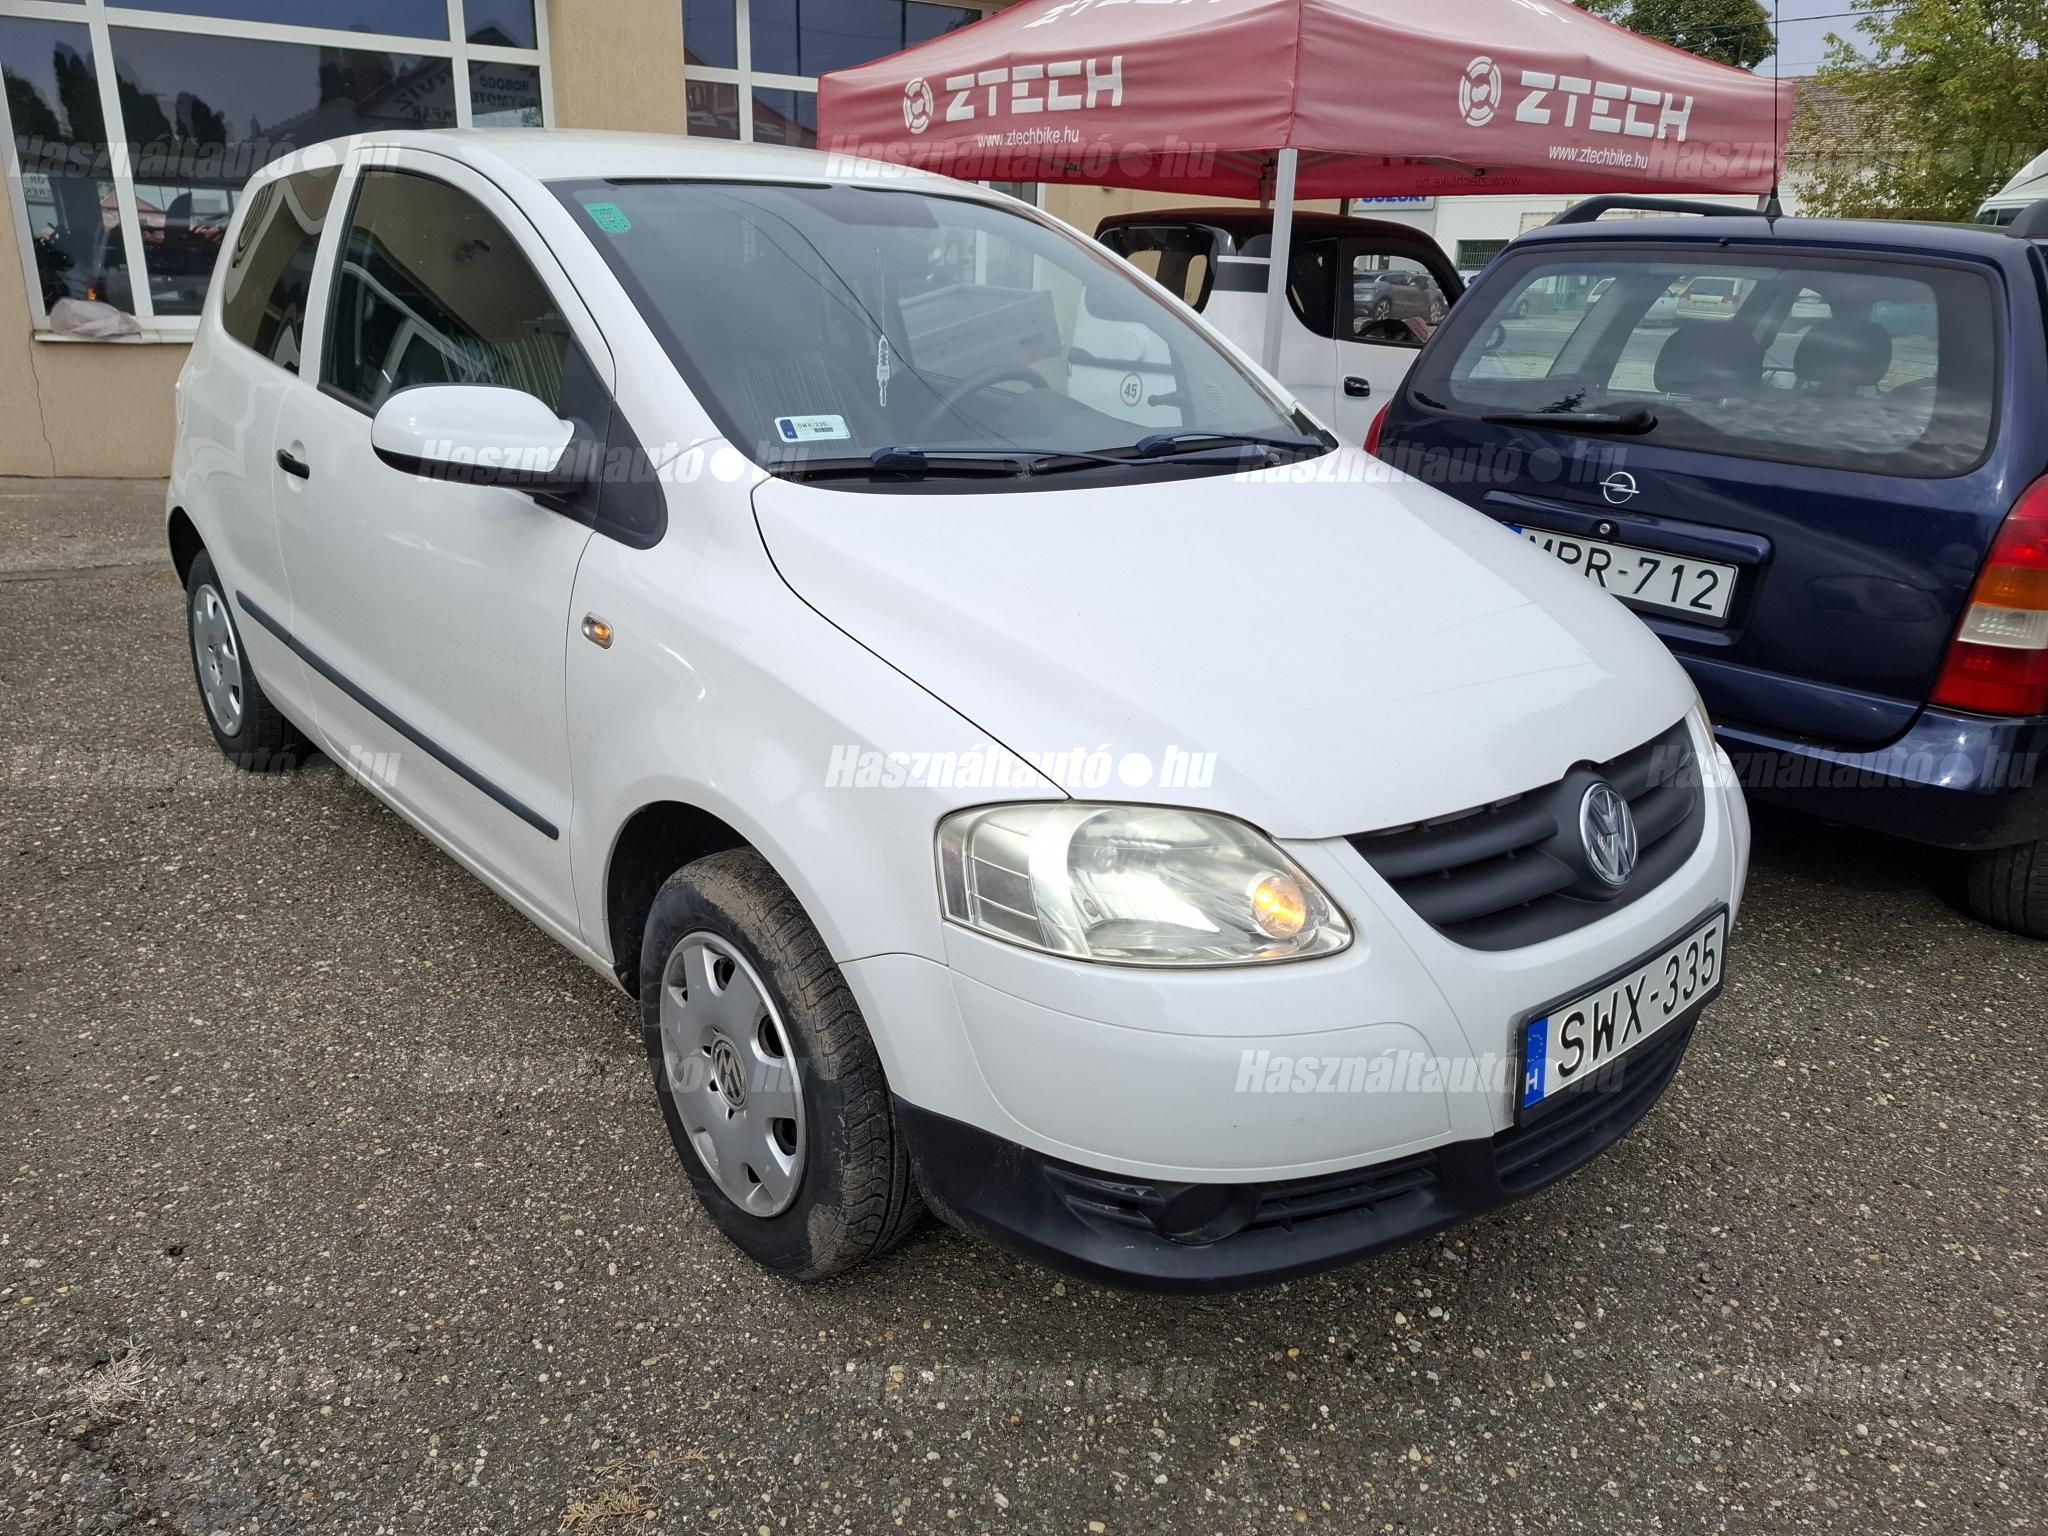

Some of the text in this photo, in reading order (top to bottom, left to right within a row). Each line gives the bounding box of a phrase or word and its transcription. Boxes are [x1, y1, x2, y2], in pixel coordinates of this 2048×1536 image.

[946, 55, 1123, 122] ZTECH
[1515, 70, 1694, 142] ZTECH
[977, 125, 1080, 148] www.ztechbike.hu
[1549, 145, 1649, 170] www.ztechbike.hu
[1124, 383, 1137, 398] 45
[1557, 926, 1717, 1078] SWX-335
